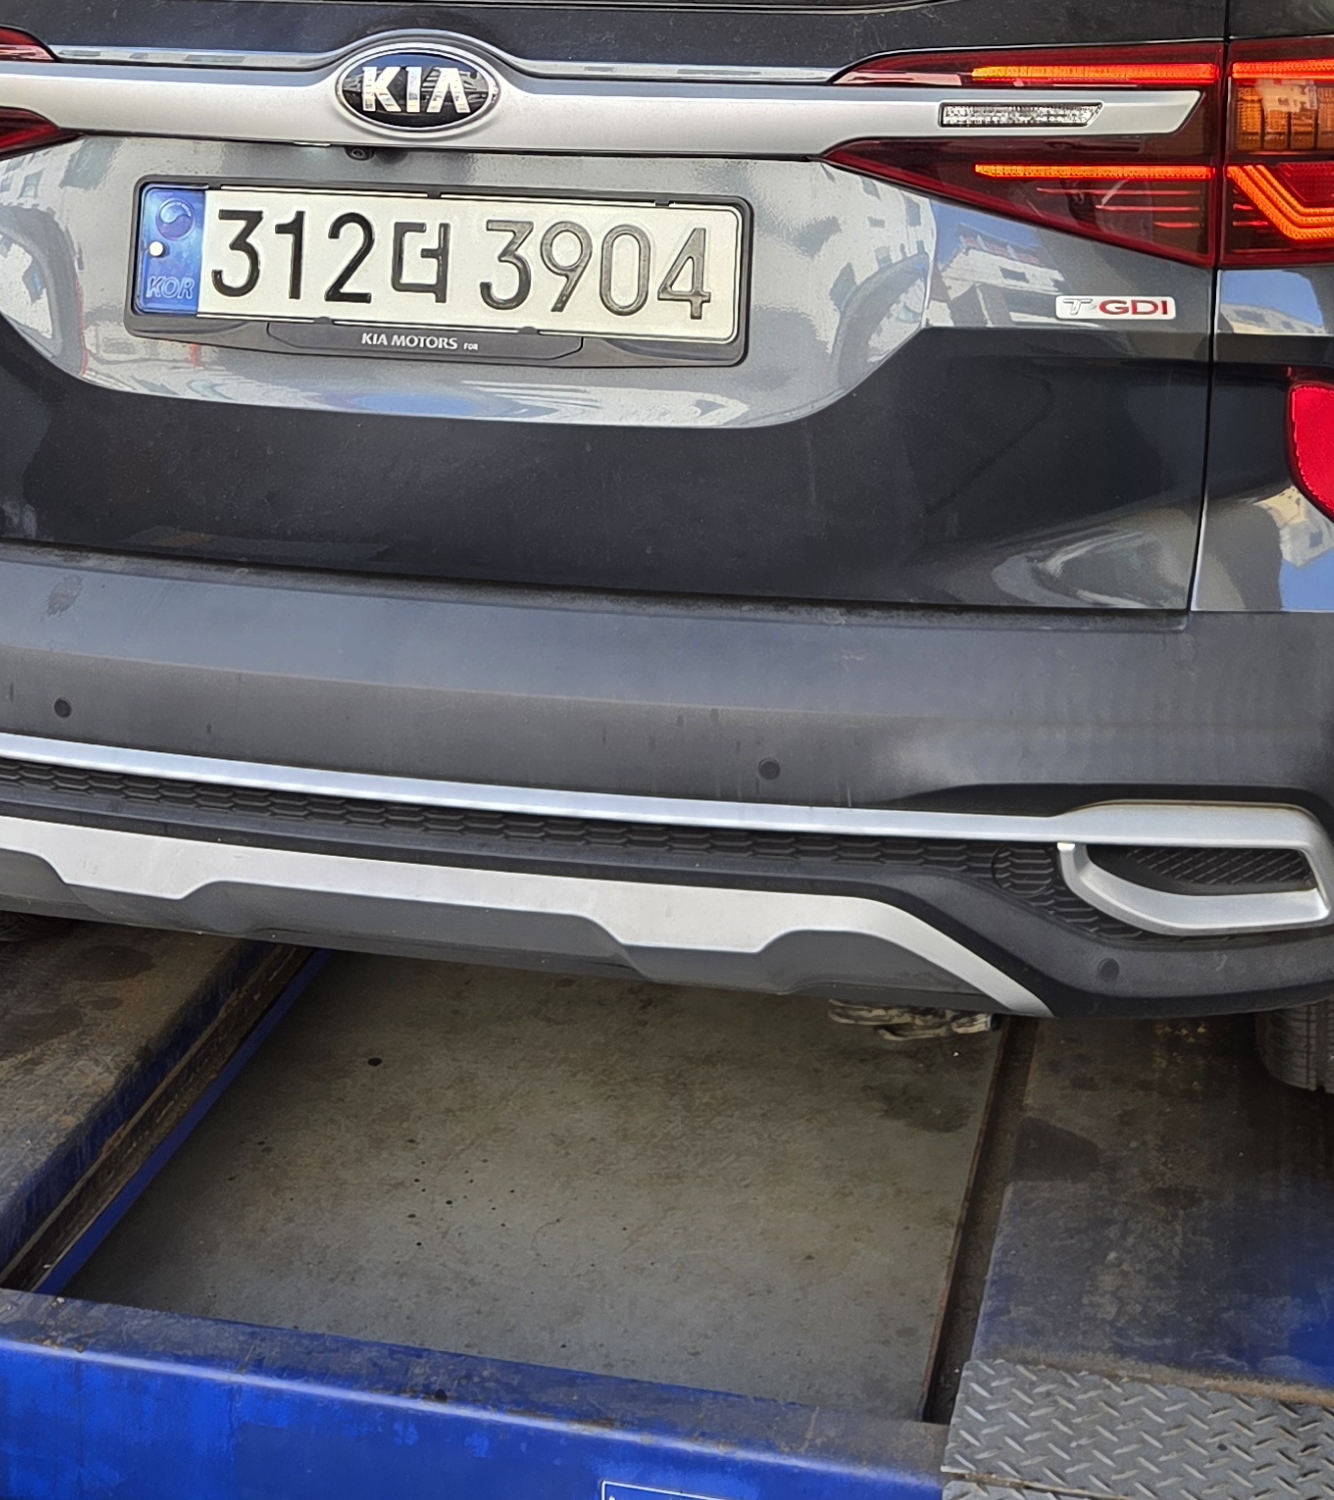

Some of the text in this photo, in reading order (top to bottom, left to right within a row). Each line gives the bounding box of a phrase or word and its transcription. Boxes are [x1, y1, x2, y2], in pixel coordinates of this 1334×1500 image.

[362, 66, 471, 113] KIA
[211, 209, 712, 320] 312더 3904
[146, 275, 195, 299] KOR
[361, 332, 388, 346] KIA
[391, 334, 458, 349] MOTORS
